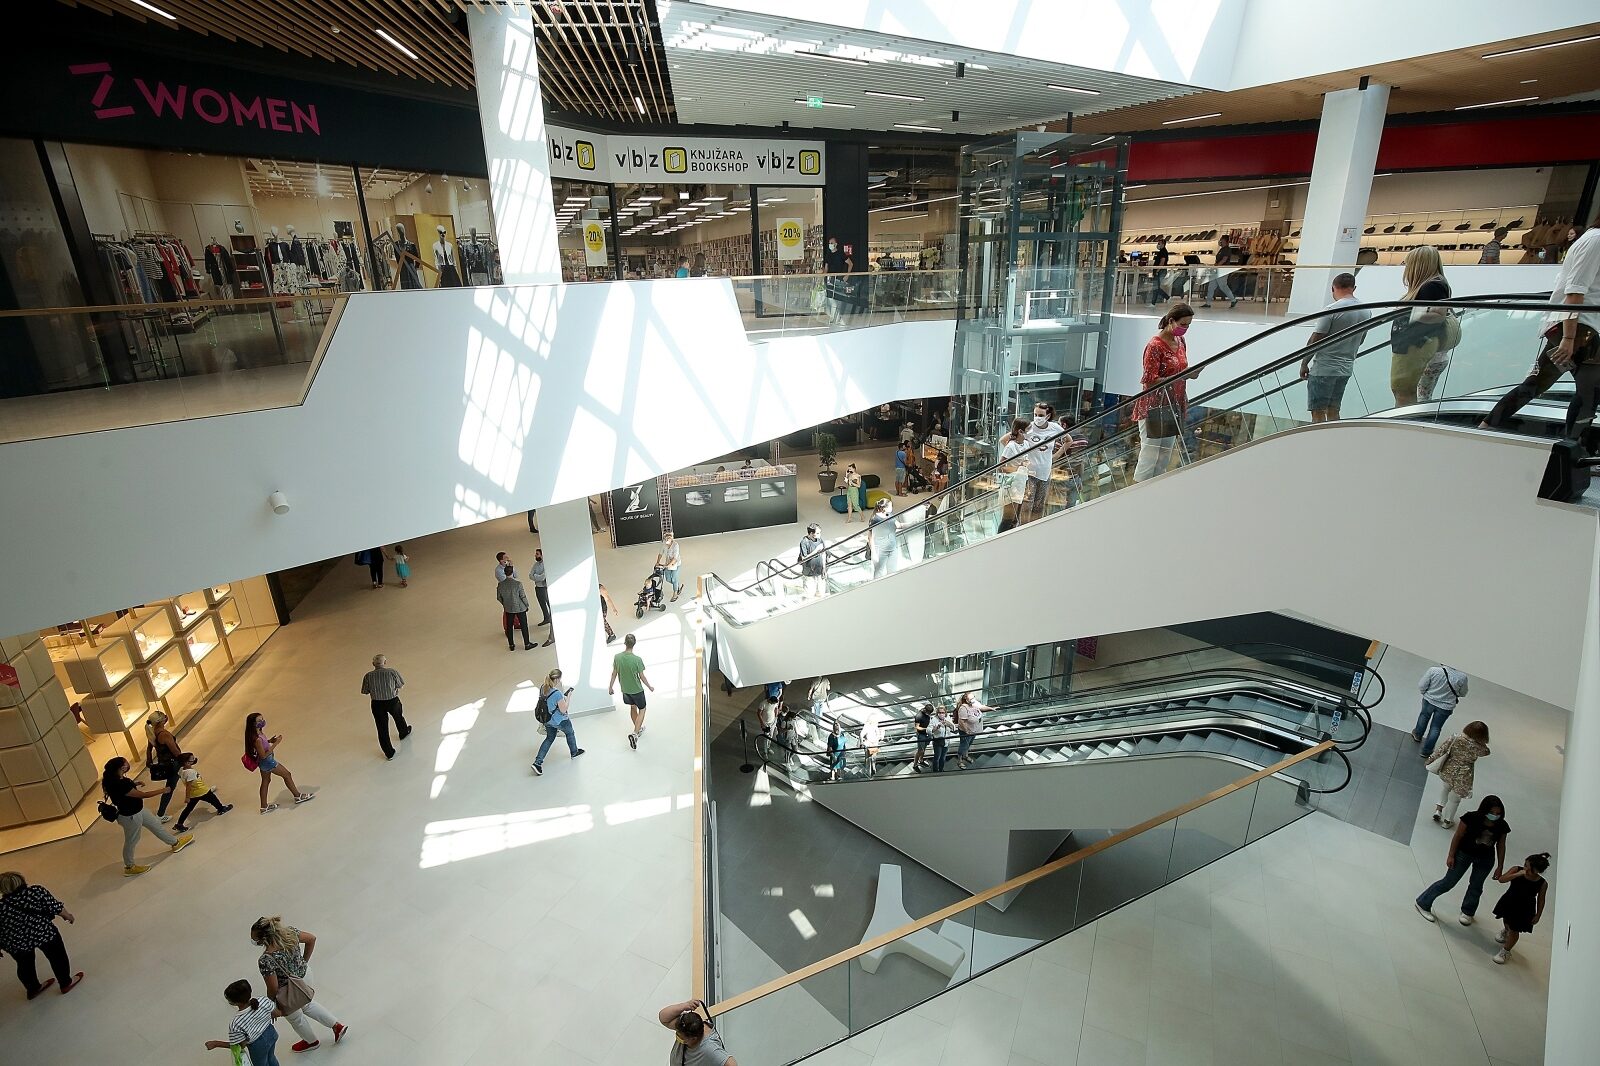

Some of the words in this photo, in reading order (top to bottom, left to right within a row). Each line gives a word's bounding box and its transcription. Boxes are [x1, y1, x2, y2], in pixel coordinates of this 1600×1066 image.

[68, 62, 135, 119] Z
[133, 78, 320, 136] WOMEN
[690, 147, 744, 160] KNJIŽARA
[691, 162, 749, 172] BOOKSHOP
[780, 228, 800, 238] -20%
